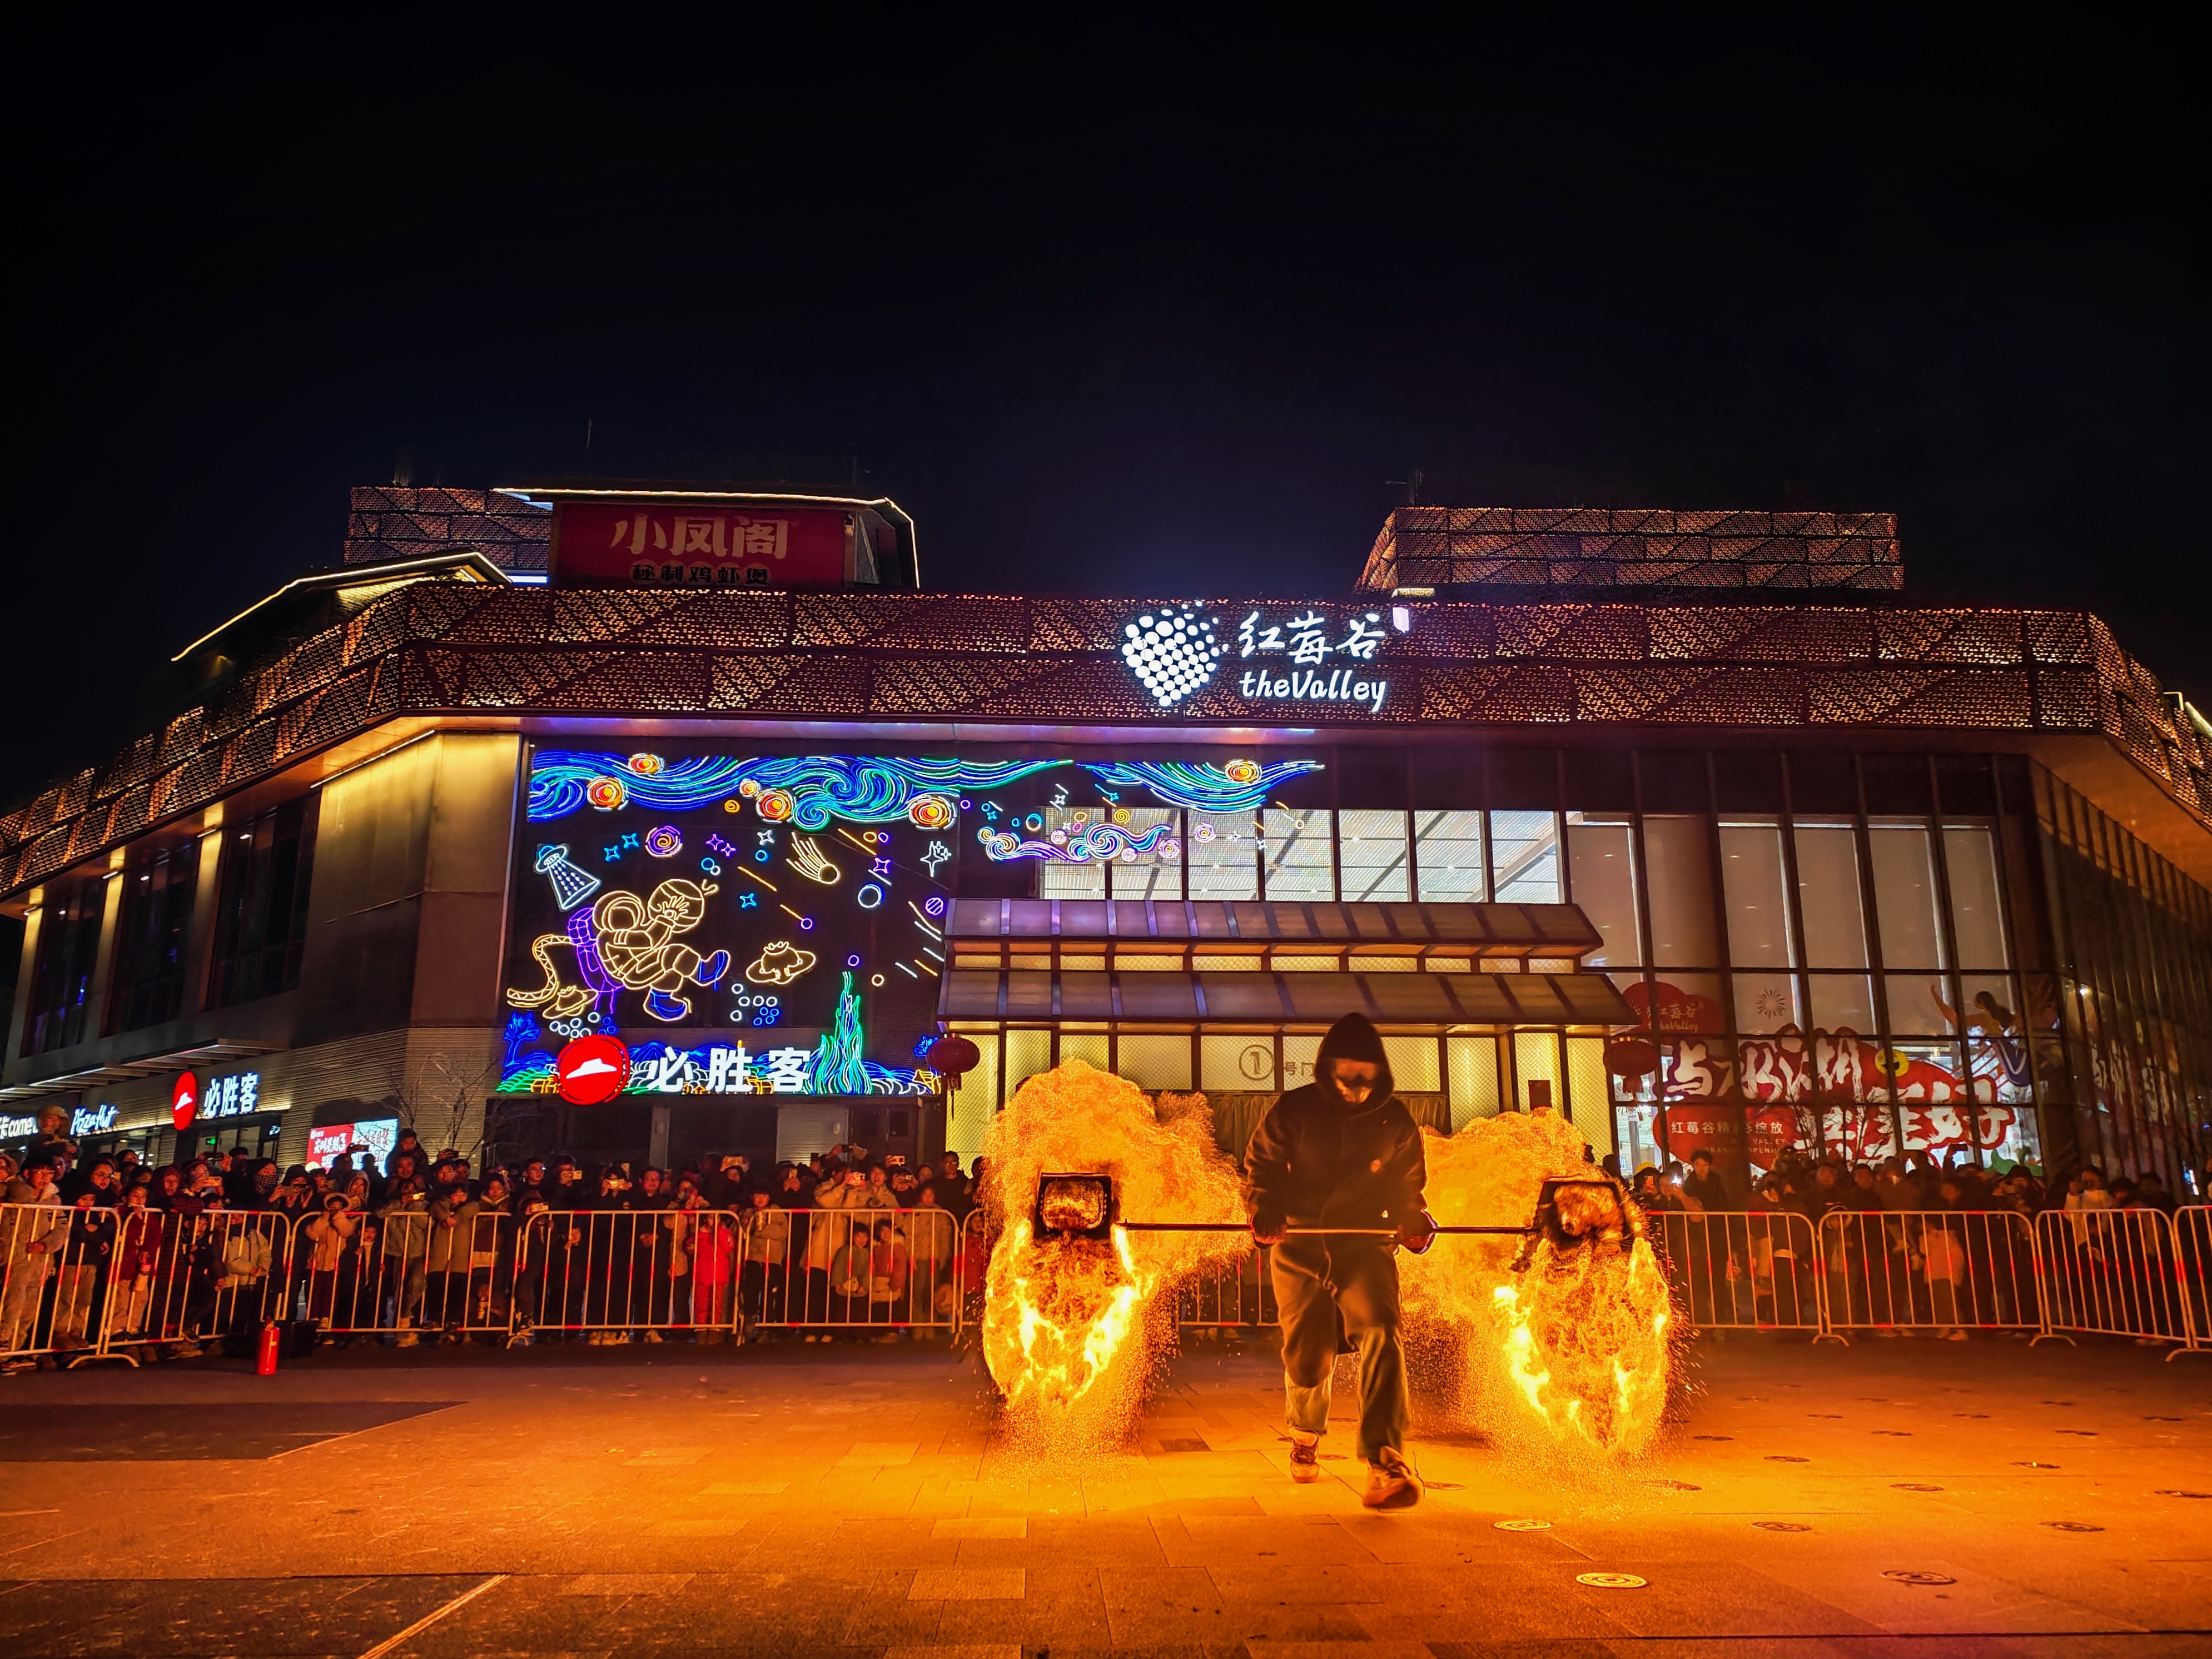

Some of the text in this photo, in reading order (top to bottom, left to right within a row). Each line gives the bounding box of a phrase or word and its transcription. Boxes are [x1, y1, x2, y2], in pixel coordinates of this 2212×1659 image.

[610, 513, 789, 559] 小凤阁
[1238, 611, 1385, 665] 红莓谷
[647, 1047, 811, 1093] 必胜客
[203, 1073, 259, 1117] 必胜客
